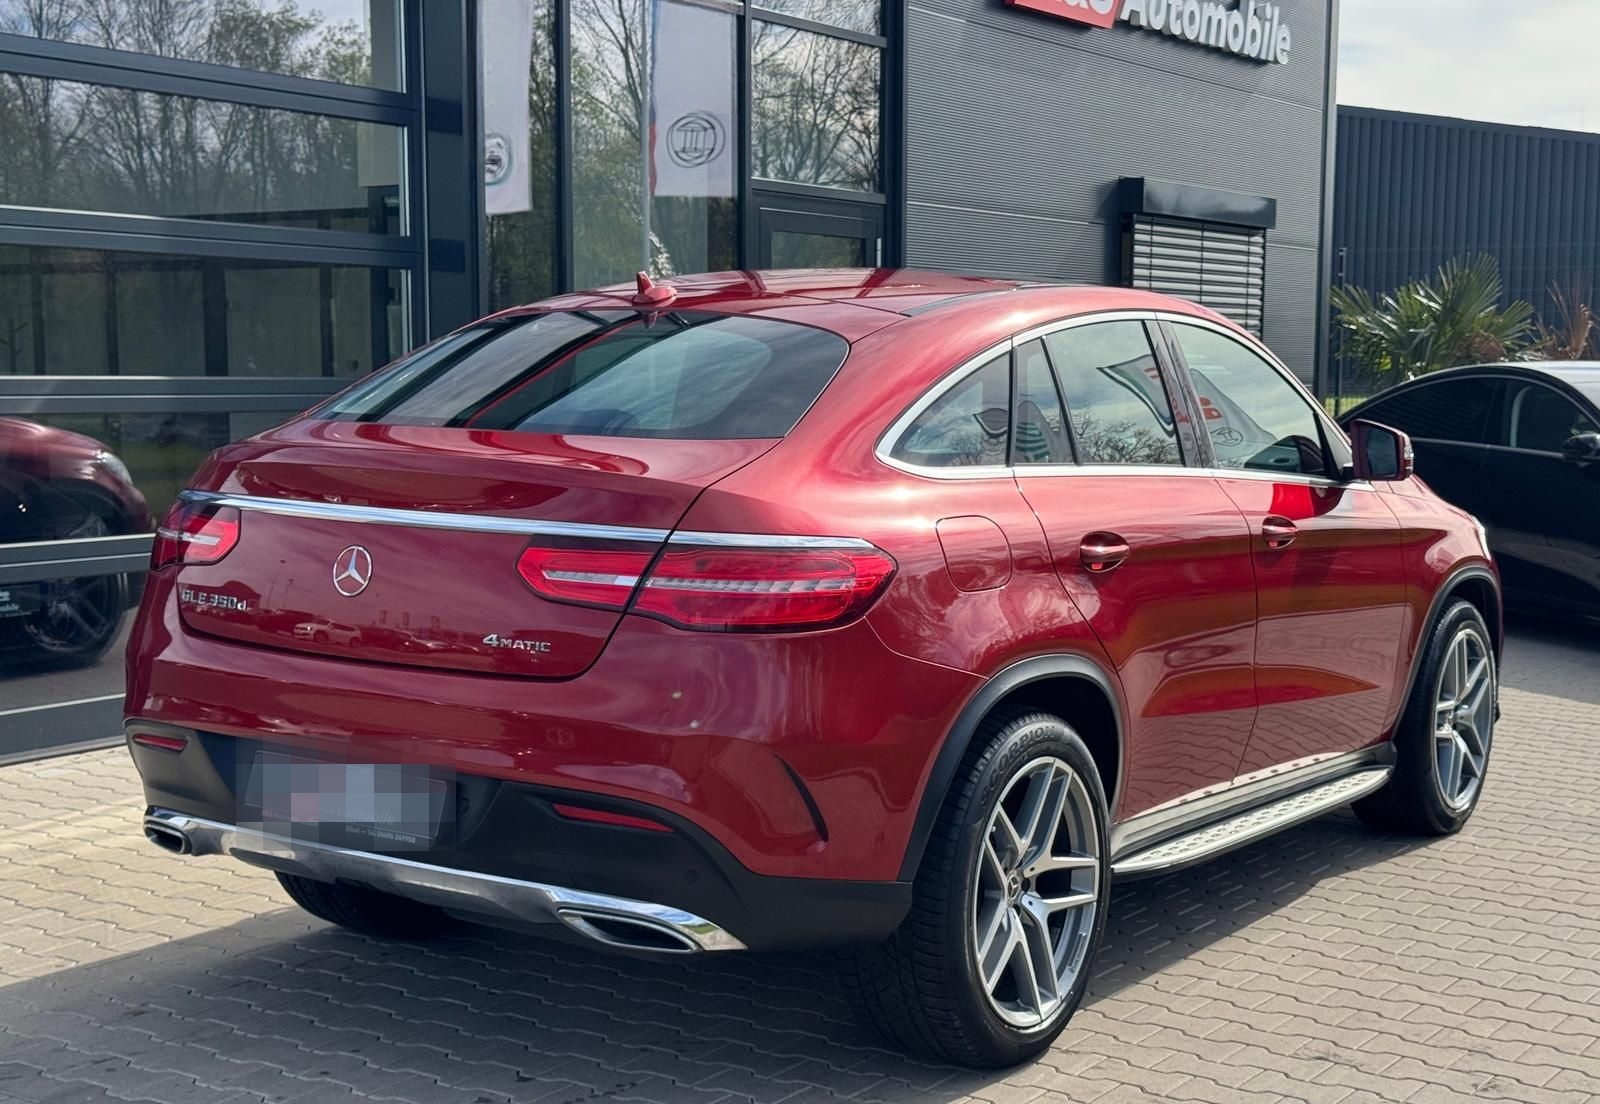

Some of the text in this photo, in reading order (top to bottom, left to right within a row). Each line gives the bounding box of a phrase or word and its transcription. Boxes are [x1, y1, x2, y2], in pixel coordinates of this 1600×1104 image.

[1120, 0, 1291, 64] Automobile
[181, 589, 208, 605] GLE
[482, 633, 552, 653] 4MATIC
